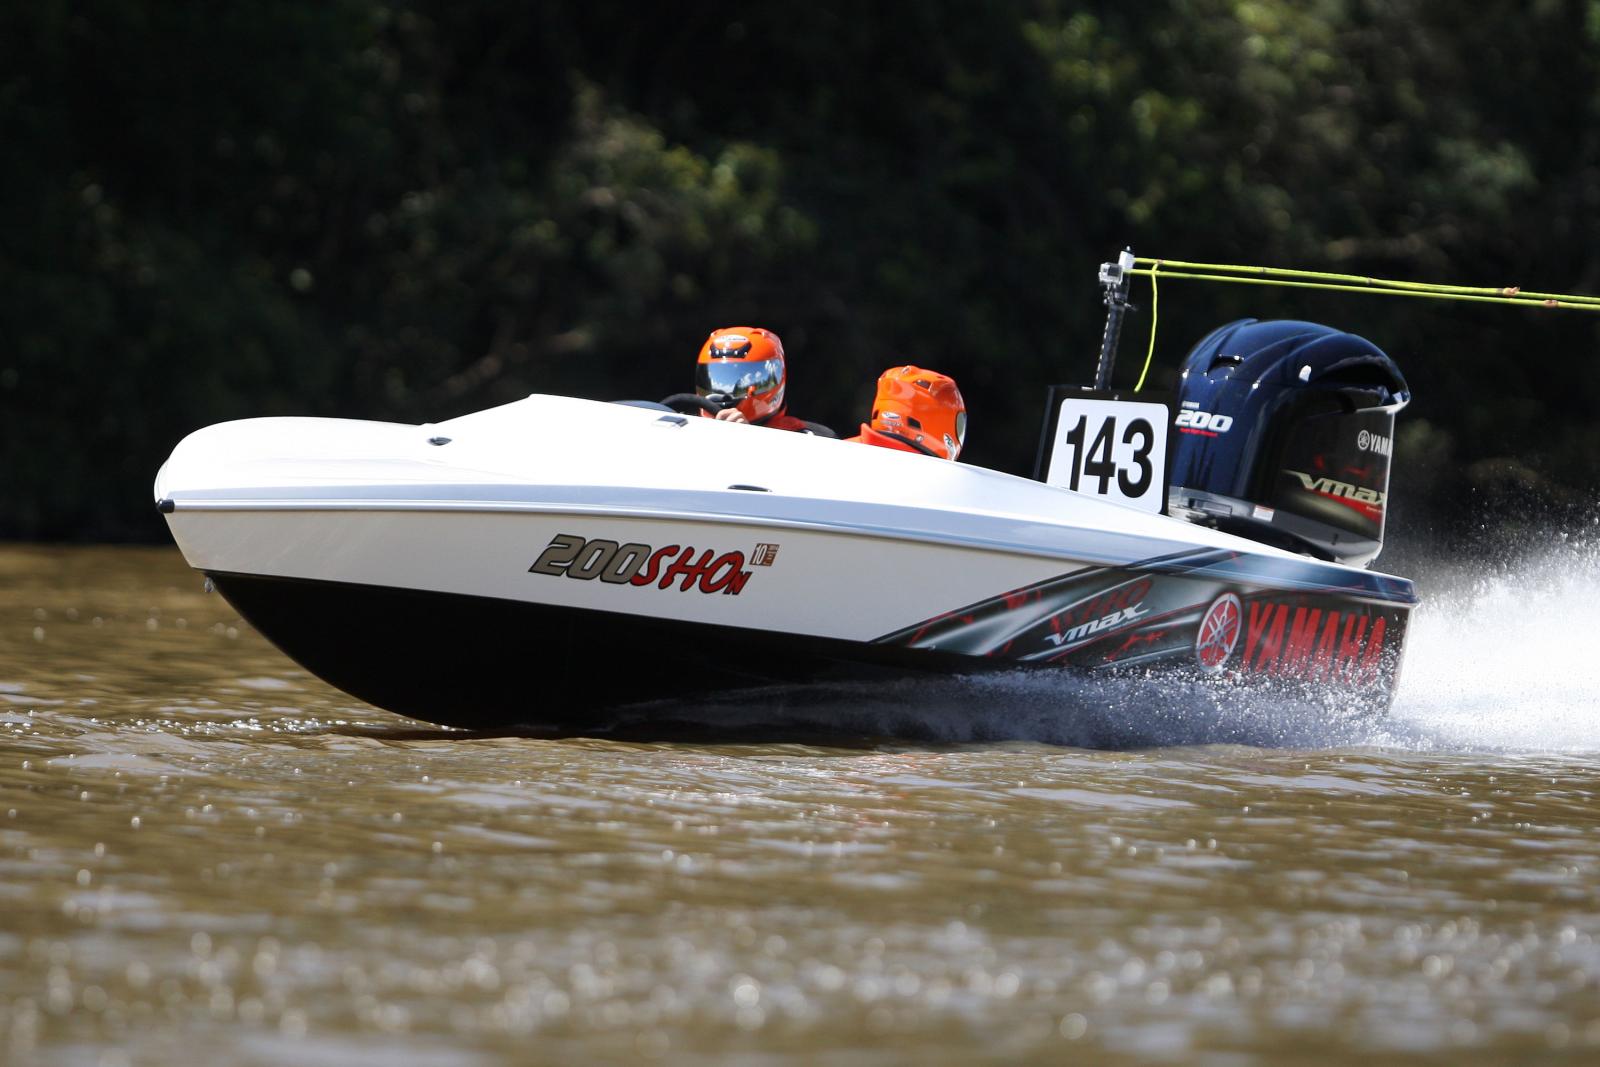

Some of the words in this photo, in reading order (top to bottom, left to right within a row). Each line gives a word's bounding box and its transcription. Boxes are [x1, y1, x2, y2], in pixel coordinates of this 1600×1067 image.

[1067, 415, 1154, 498] 143
[1175, 409, 1233, 432] 200
[1240, 601, 1386, 687] YAMAHA
